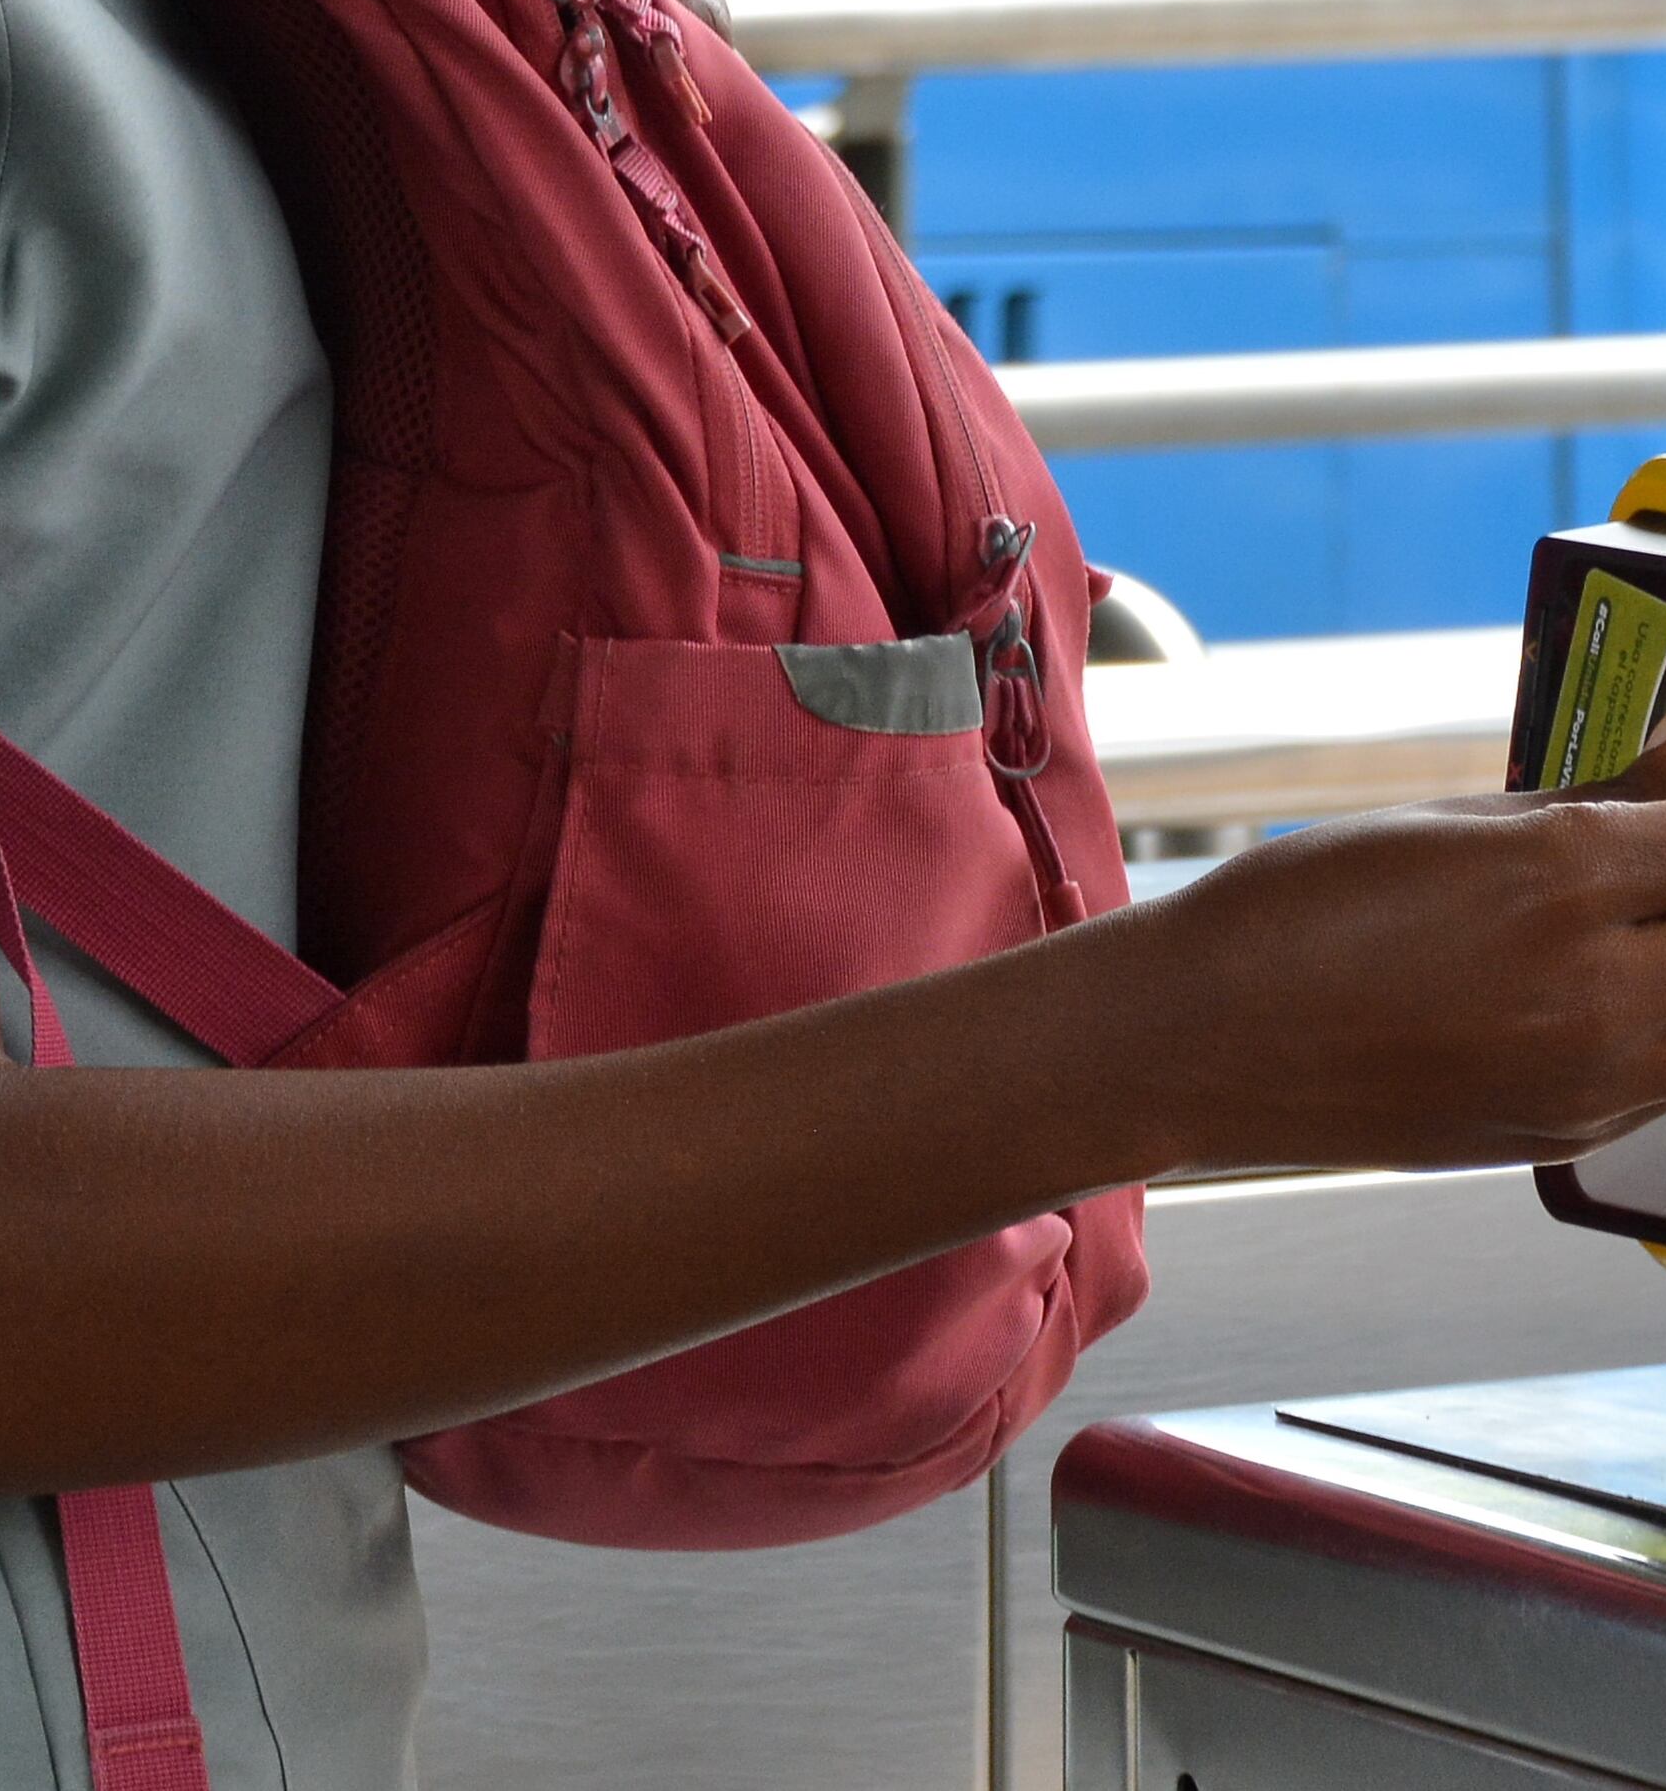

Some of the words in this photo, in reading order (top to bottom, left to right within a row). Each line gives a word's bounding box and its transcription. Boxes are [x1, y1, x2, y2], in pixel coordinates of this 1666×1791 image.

[1618, 649, 1628, 669] el
[1633, 622, 1649, 663] Usa
[1558, 602, 1608, 790] #CaliUnidaPorLaVi
[1593, 674, 1623, 779] tapaboca
[1607, 669, 1636, 777] correctam
